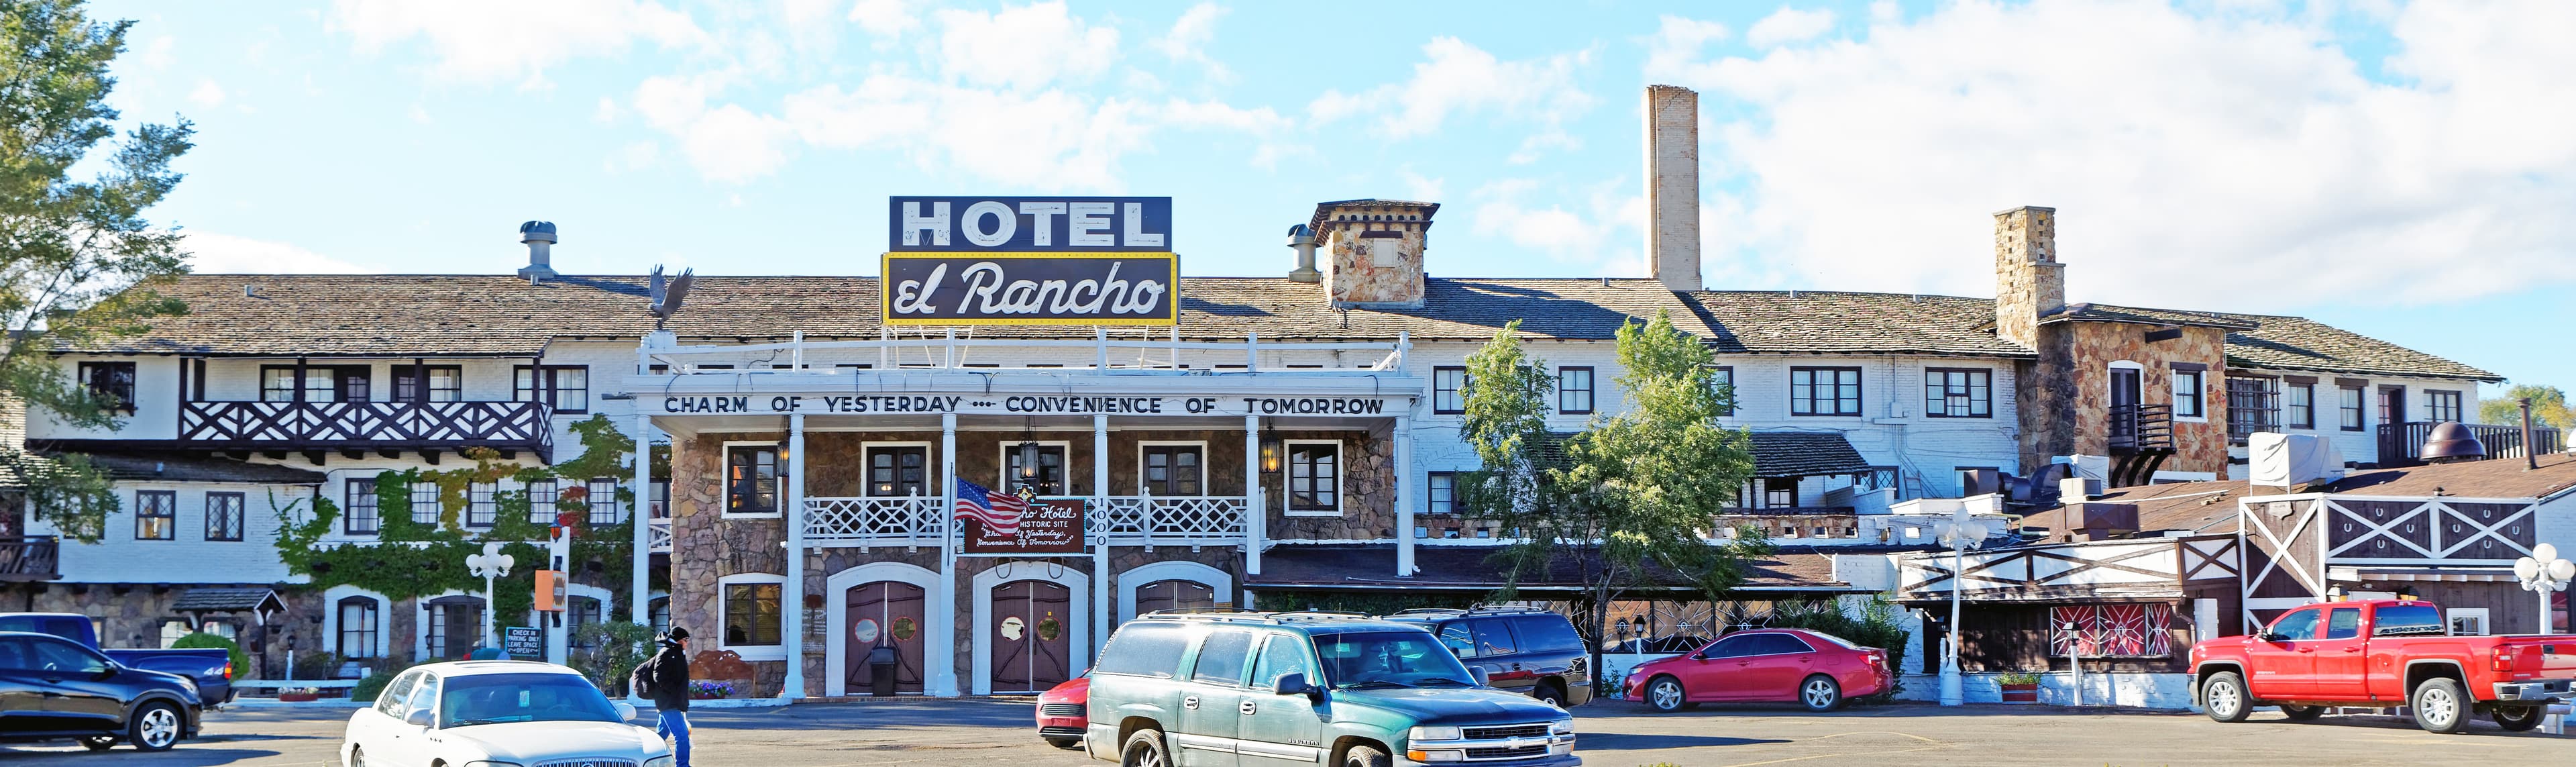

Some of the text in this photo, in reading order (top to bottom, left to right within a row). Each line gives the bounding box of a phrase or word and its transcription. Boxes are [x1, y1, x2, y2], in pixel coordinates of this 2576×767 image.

[903, 201, 1164, 247] HOTEL
[956, 262, 1165, 314] Rancho
[664, 396, 1384, 414] CHARM OF YESTERDAY CONVENIENCE OF TOMORROW
[1040, 505, 1077, 519] Hotel
[1097, 498, 1106, 546] 1000
[977, 538, 1015, 547] Convenience
[1017, 539, 1027, 548] Of
[1288, 737, 1320, 746] SUBURBAN
